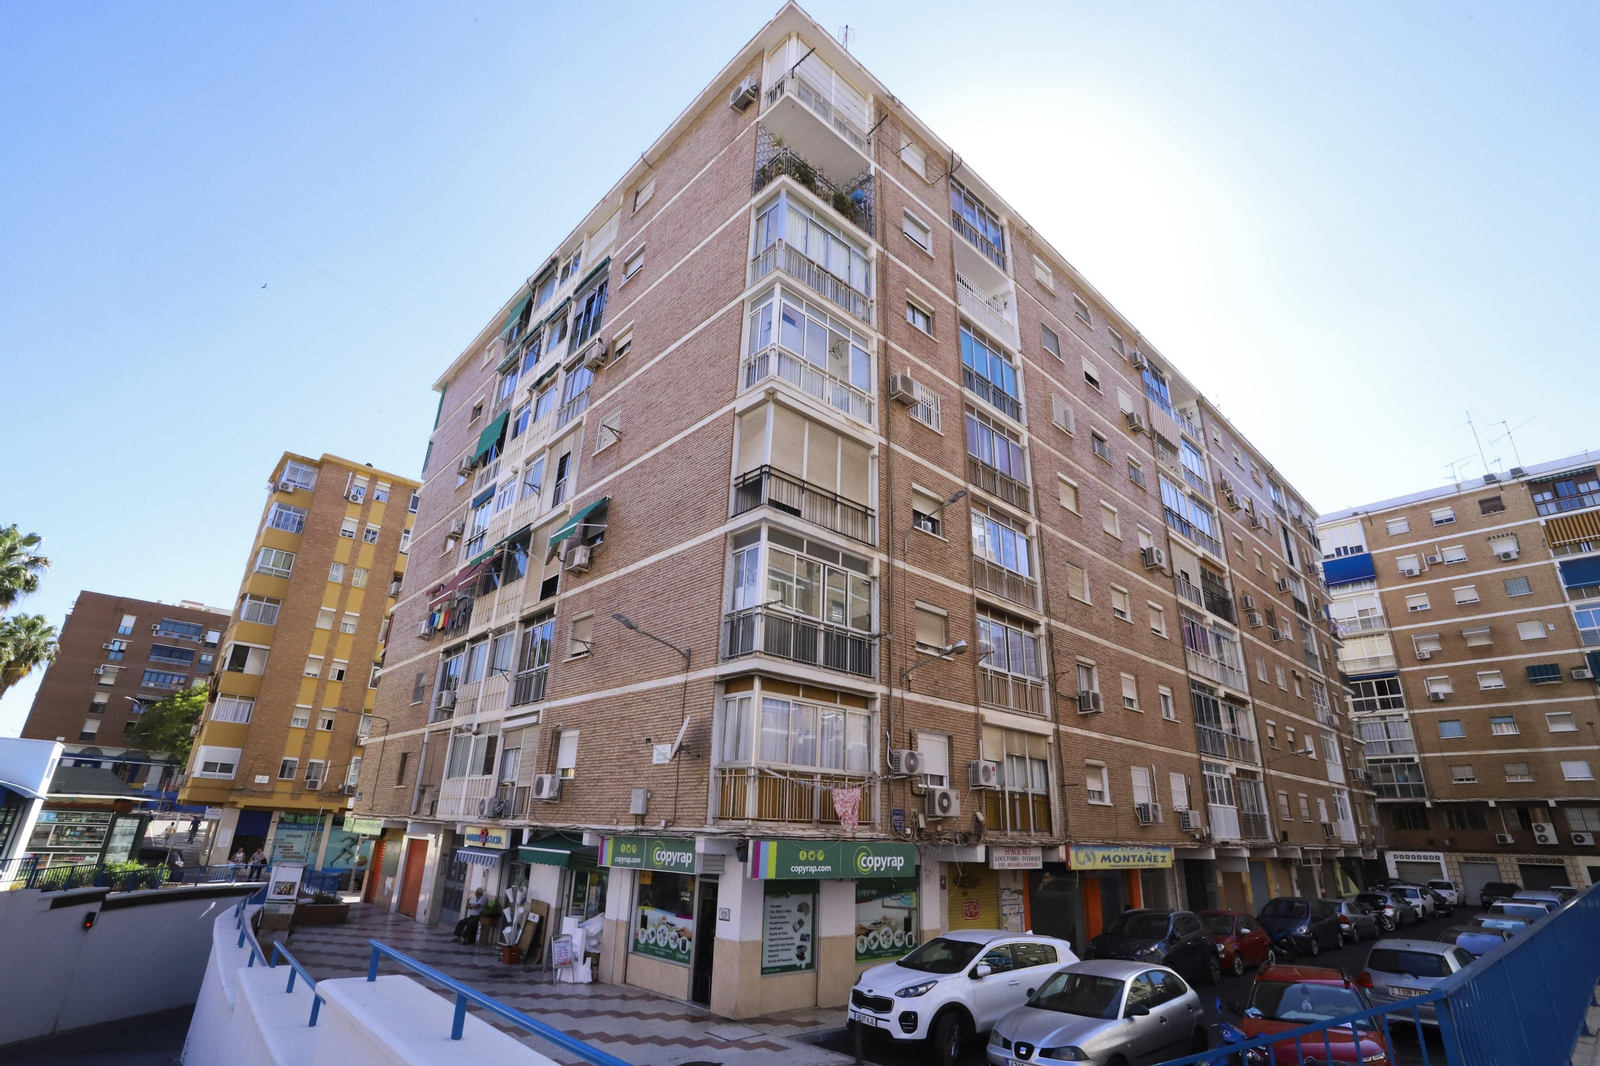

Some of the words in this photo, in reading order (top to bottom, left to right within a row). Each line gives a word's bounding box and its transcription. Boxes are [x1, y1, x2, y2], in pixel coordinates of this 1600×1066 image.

[614, 856, 641, 865] copyrap.com
[860, 855, 904, 871] copyrap
[1100, 852, 1167, 864] MONTAÑEZ
[790, 865, 832, 874] copyrap.com
